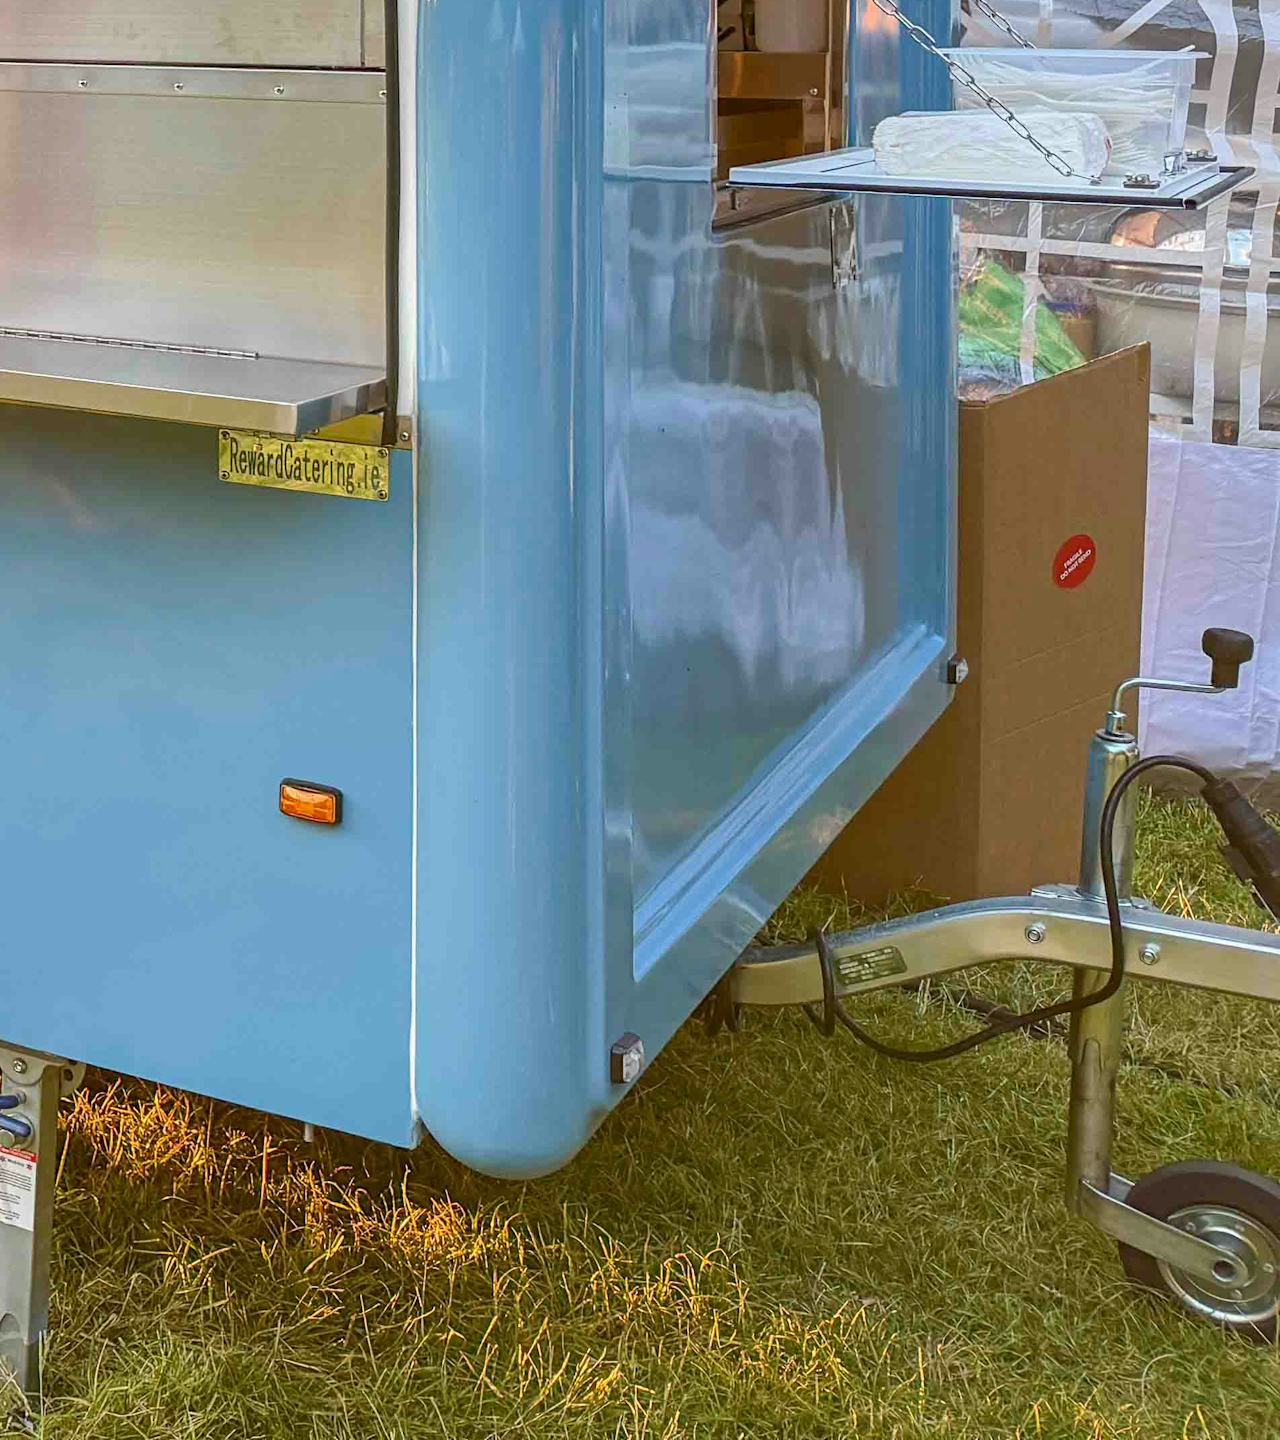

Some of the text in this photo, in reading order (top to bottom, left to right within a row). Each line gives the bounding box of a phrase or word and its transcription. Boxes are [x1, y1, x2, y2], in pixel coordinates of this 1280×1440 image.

[228, 436, 381, 494] RewardCatering.ie
[1060, 549, 1092, 581] DO NOT BEND
[1064, 549, 1082, 569] FRAGILE
